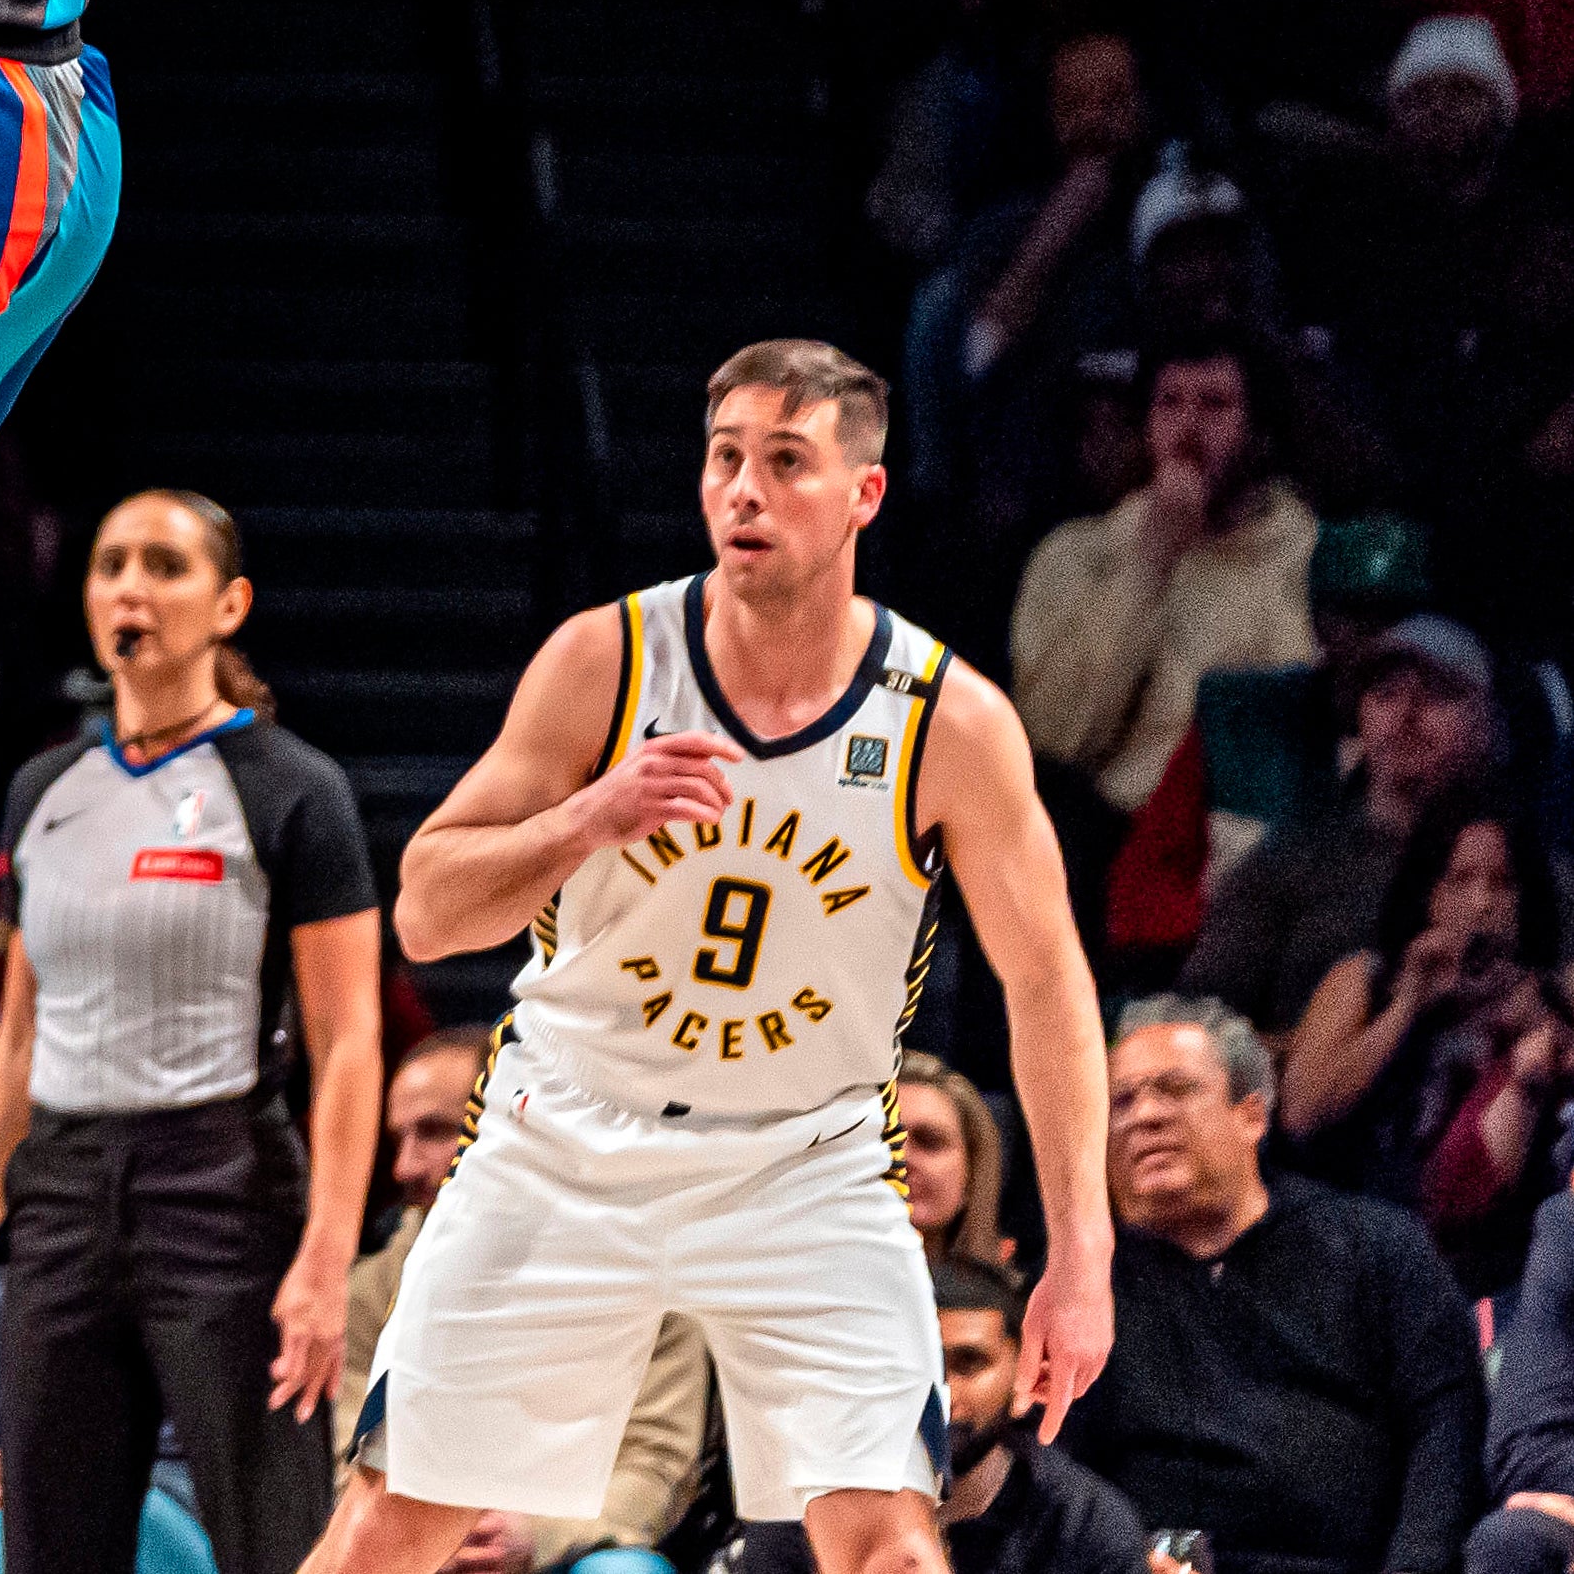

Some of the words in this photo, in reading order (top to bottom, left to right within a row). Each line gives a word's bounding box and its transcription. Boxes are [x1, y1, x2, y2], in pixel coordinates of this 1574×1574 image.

[619, 797, 872, 918] INDIANA
[690, 875, 774, 992] 9
[618, 955, 835, 1063] PACERS
